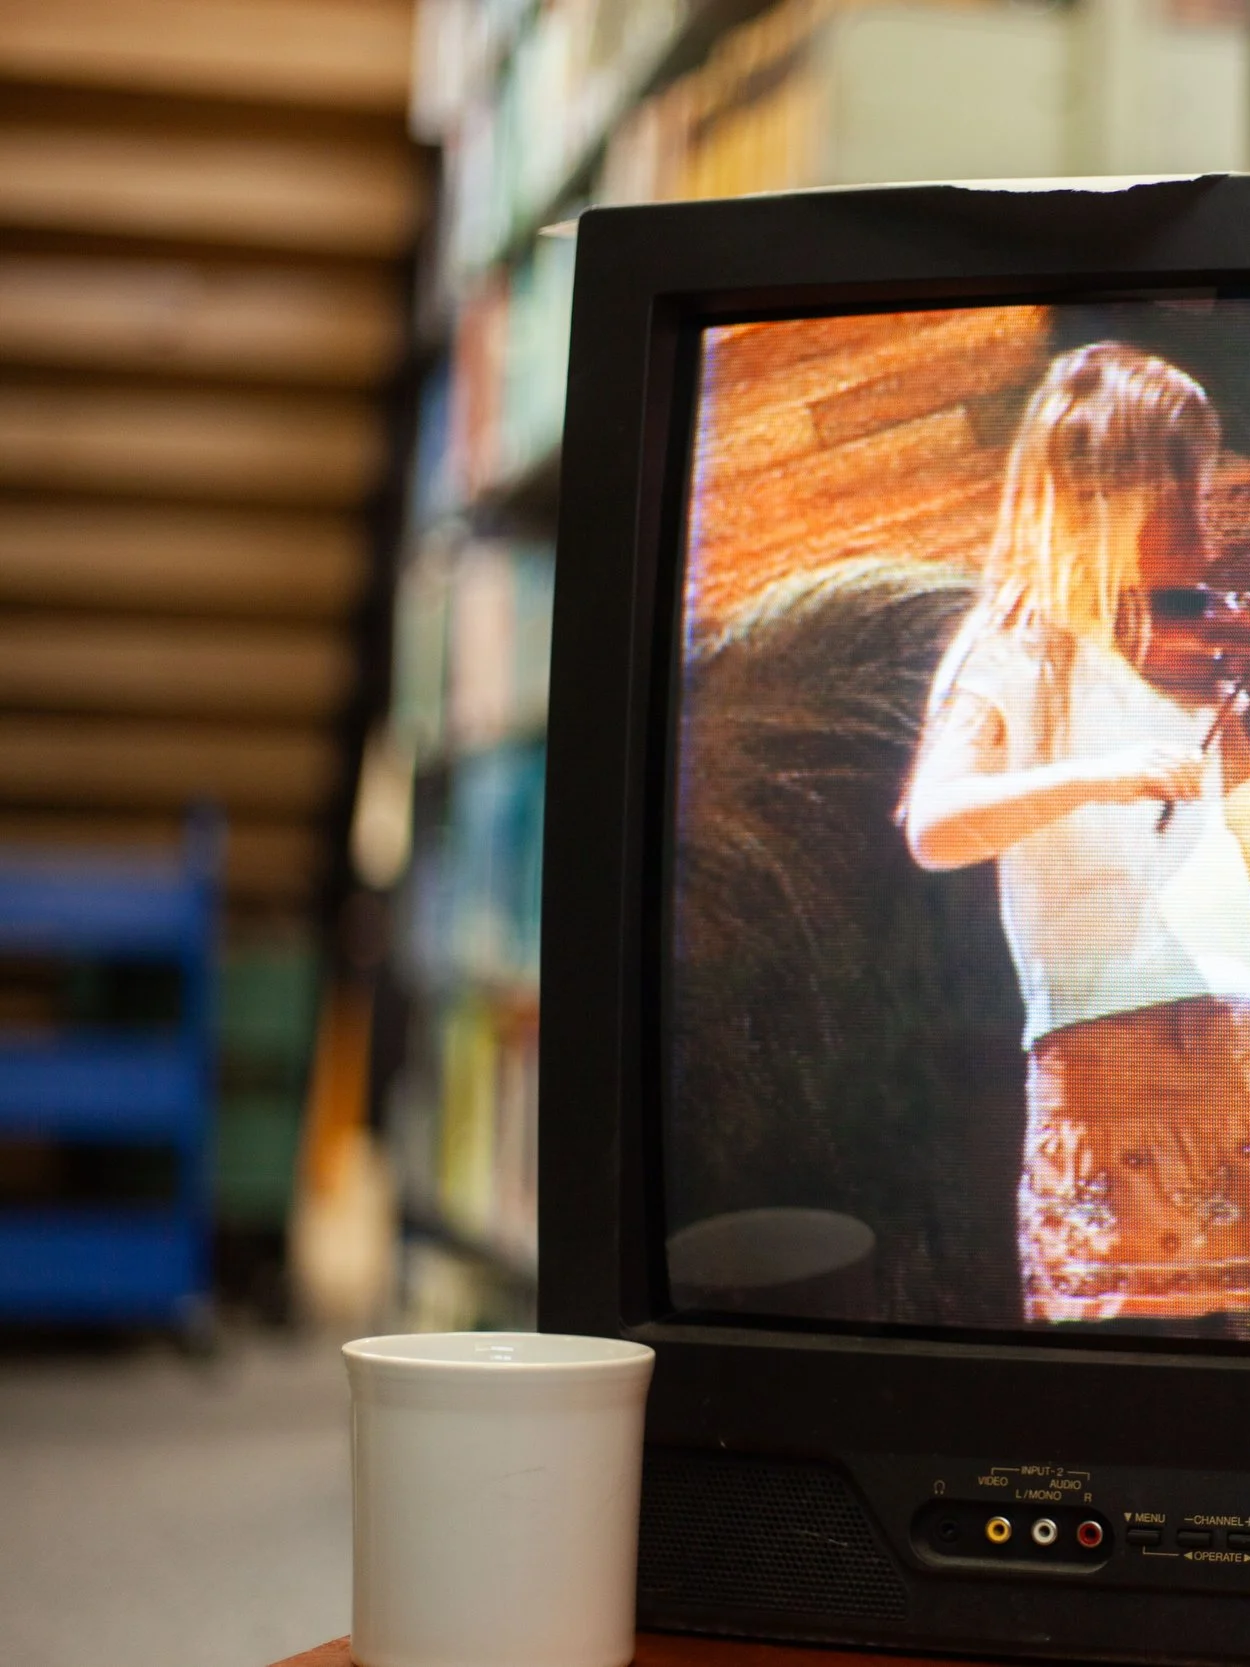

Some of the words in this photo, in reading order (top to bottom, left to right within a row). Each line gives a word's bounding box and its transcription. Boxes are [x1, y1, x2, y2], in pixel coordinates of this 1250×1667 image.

[1020, 1465, 1065, 1477] INPUT-2
[978, 1476, 1009, 1487] VIDEO
[1049, 1479, 1082, 1490] AUDIO
[1083, 1492, 1093, 1503] R
[1135, 1512, 1166, 1524] MENU
[1194, 1551, 1243, 1563] OPERATE
